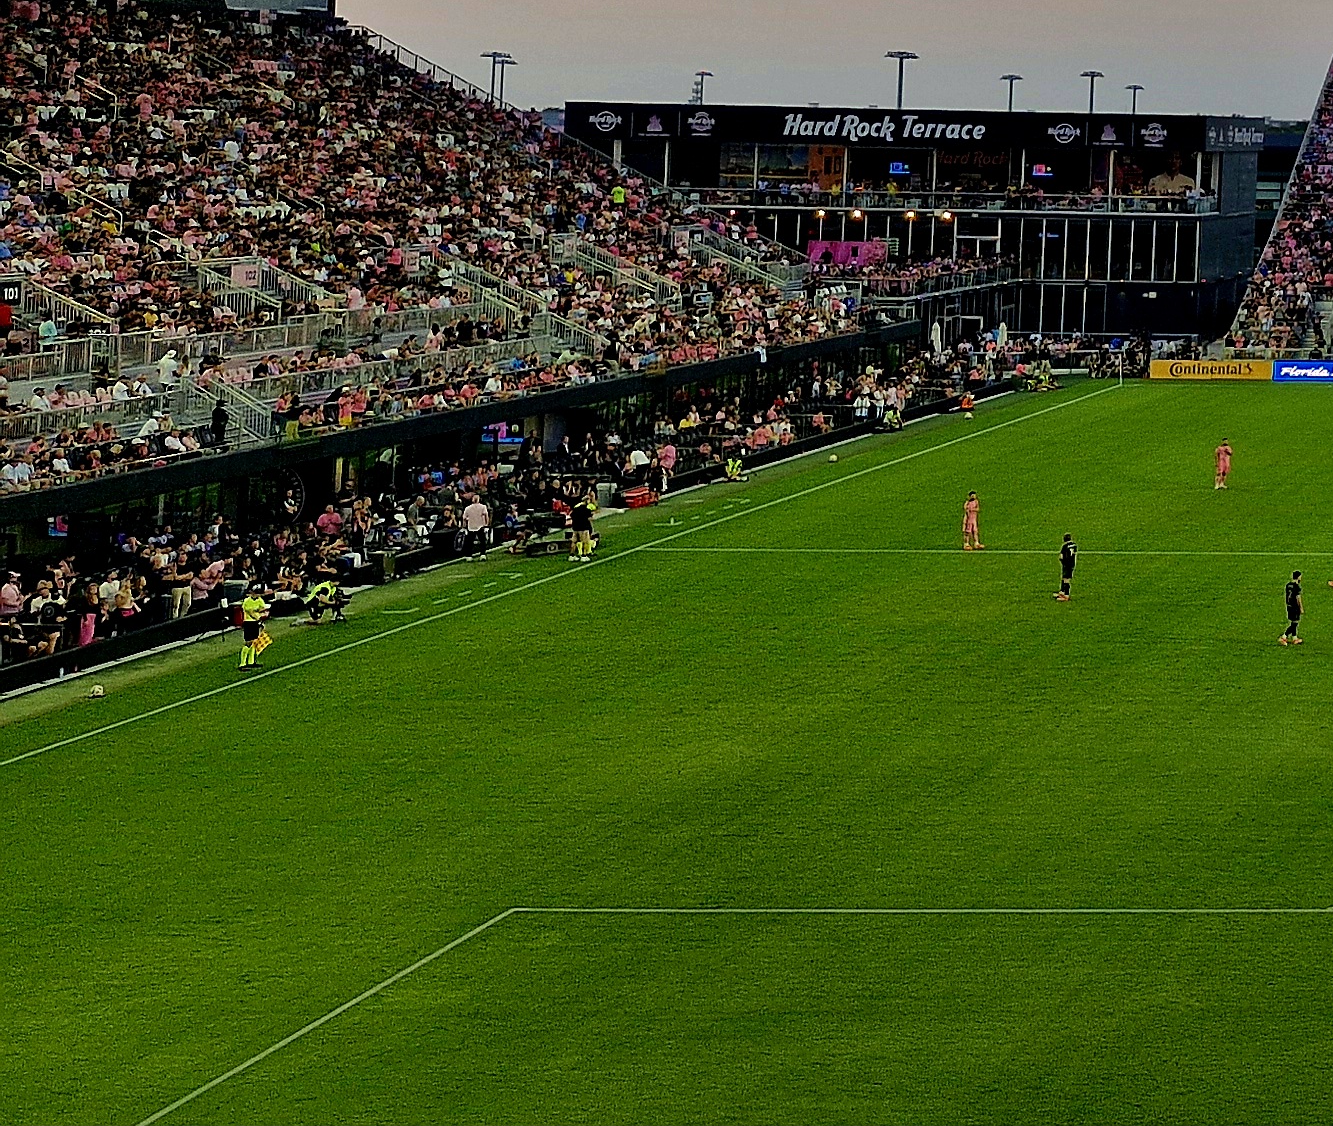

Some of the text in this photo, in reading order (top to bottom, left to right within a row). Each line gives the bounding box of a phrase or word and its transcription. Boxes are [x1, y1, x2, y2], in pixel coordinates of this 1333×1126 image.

[783, 114, 986, 142] Hard Rock Terrace
[3, 287, 19, 301] 101
[1169, 362, 1243, 377] Continental
[1280, 366, 1329, 377] Florida
